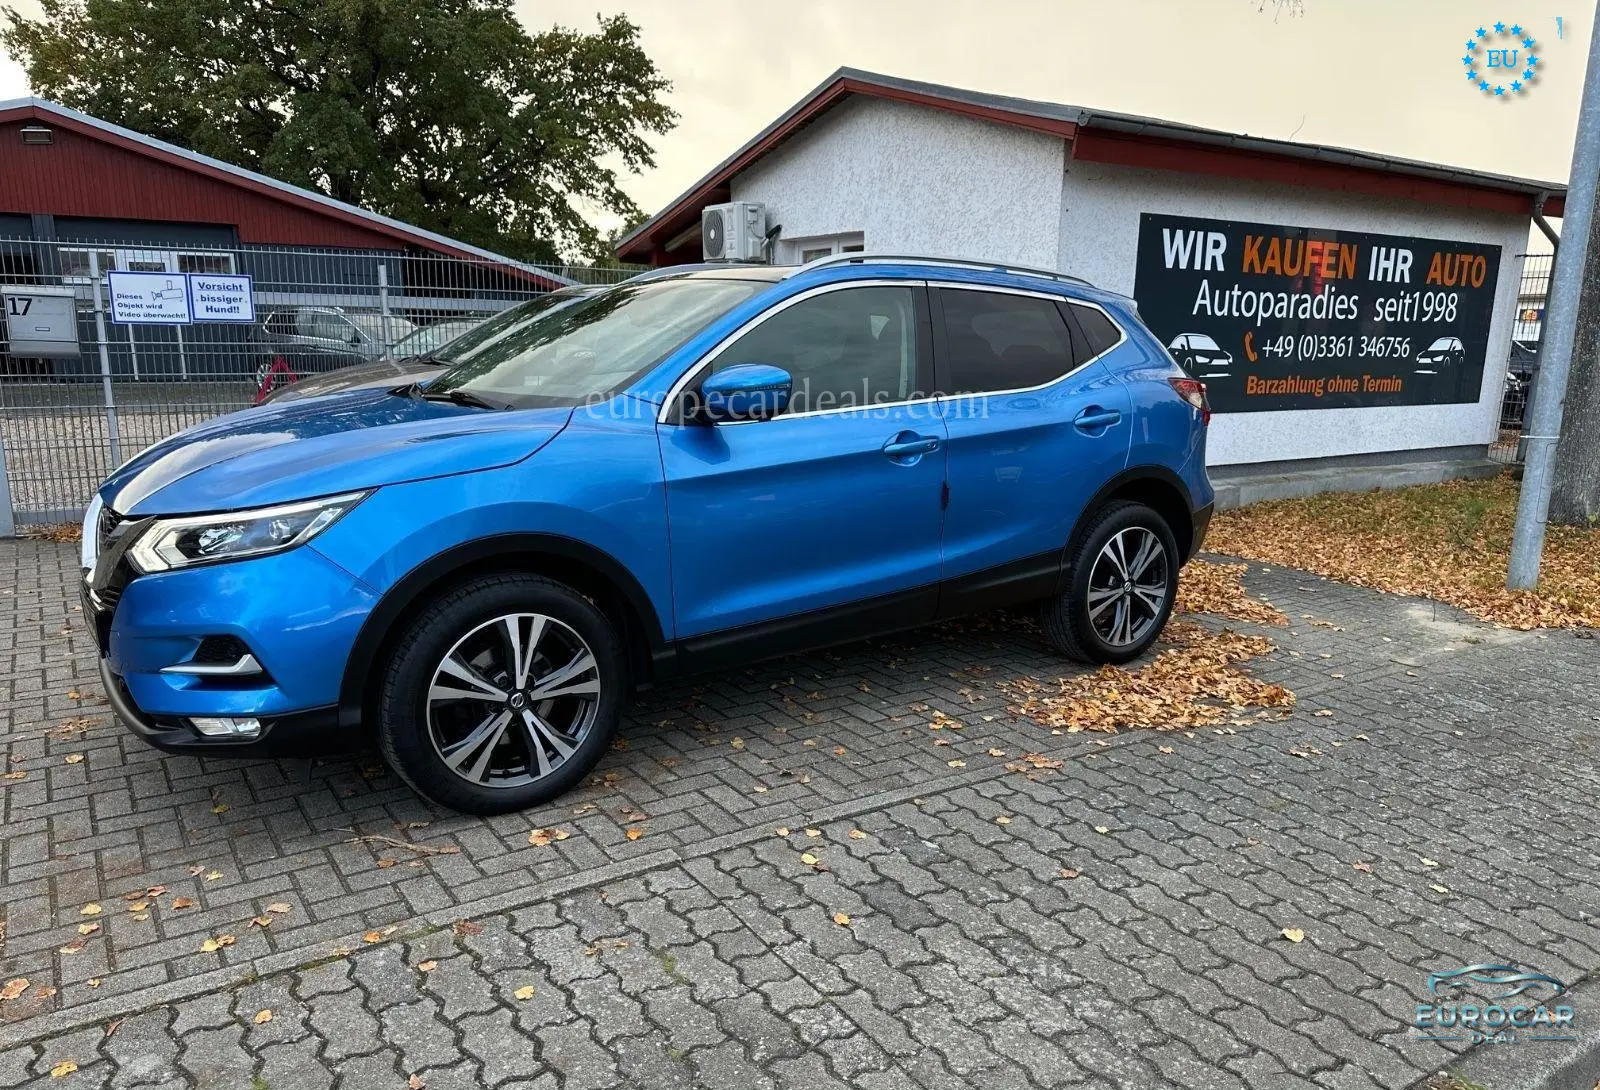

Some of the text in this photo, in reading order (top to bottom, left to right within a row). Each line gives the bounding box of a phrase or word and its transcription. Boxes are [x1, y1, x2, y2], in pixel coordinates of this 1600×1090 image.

[1162, 227, 1487, 289] WIR KAUFEN IHR AUTO
[197, 281, 244, 291] Vorsicht
[8, 297, 33, 316] 17
[117, 302, 144, 310] Objekt
[200, 294, 244, 305] bissiger
[1192, 278, 1359, 327] Autoparadies
[205, 305, 240, 314] Hund!!
[1262, 334, 1411, 361] +49 (0)3361 346756
[1246, 374, 1403, 398] Barzahlung ohne Termin
